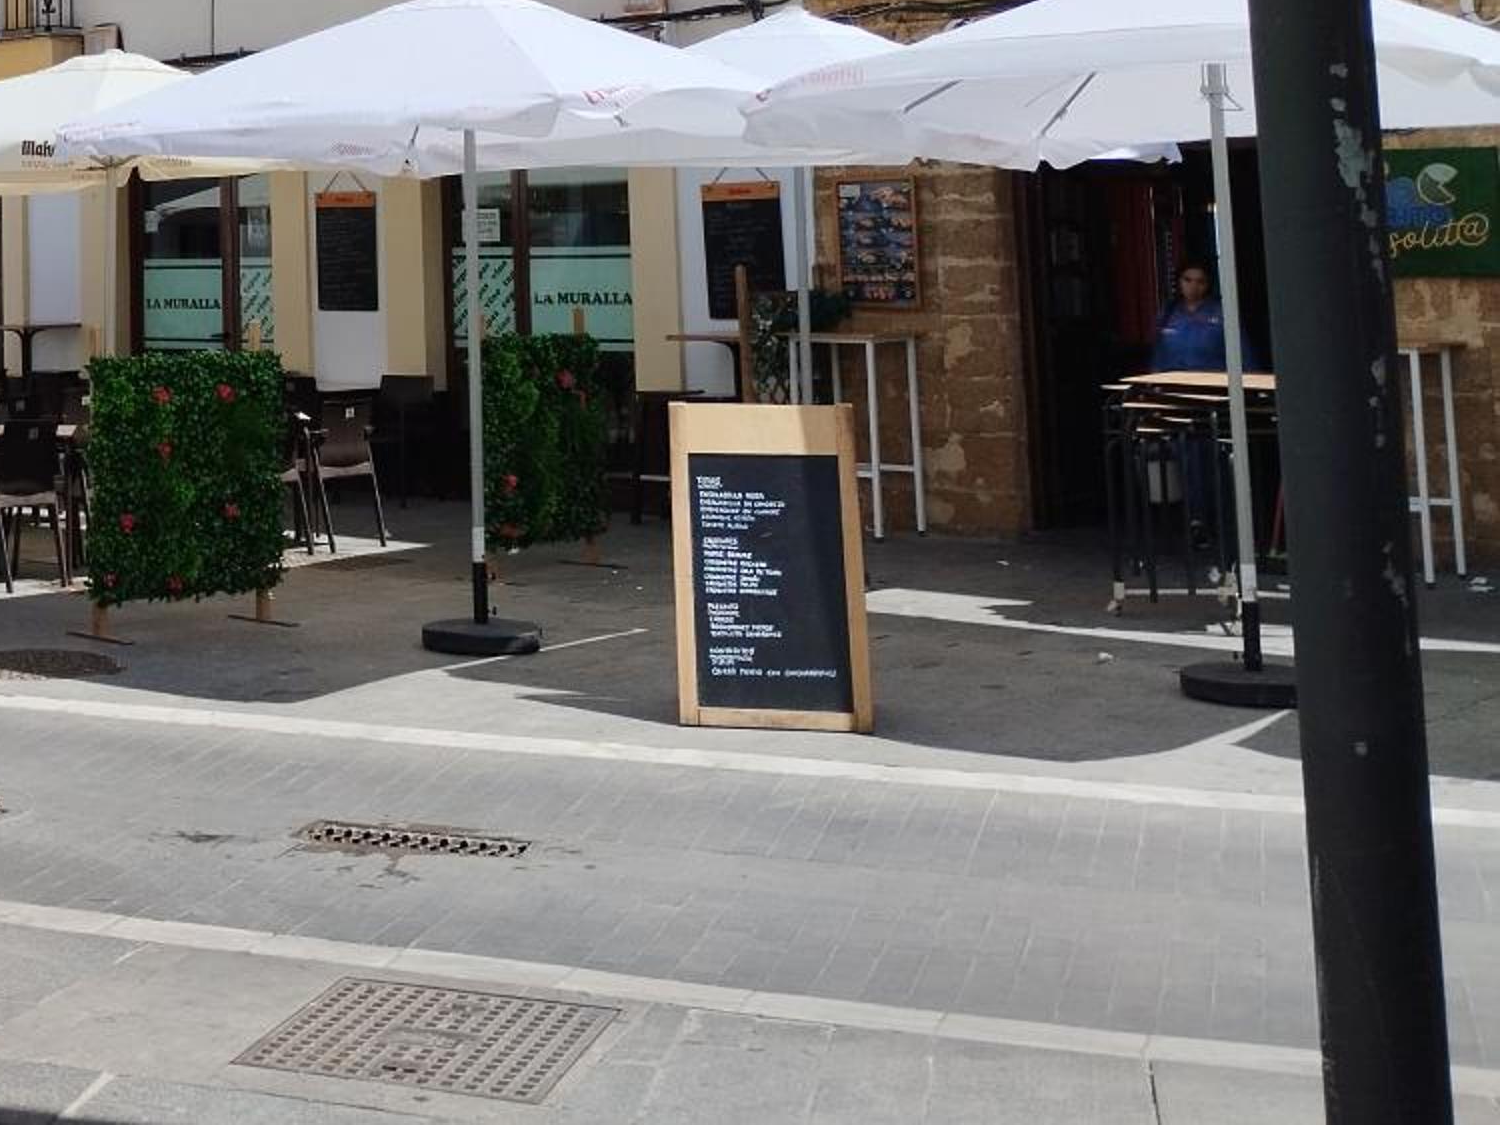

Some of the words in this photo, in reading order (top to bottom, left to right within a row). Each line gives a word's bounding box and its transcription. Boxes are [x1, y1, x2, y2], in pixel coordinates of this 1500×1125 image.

[21, 139, 55, 157] Mah
[146, 298, 161, 310] LA
[163, 298, 221, 310] MURALLA
[534, 291, 553, 305] LA
[557, 291, 633, 306] MURALLA
